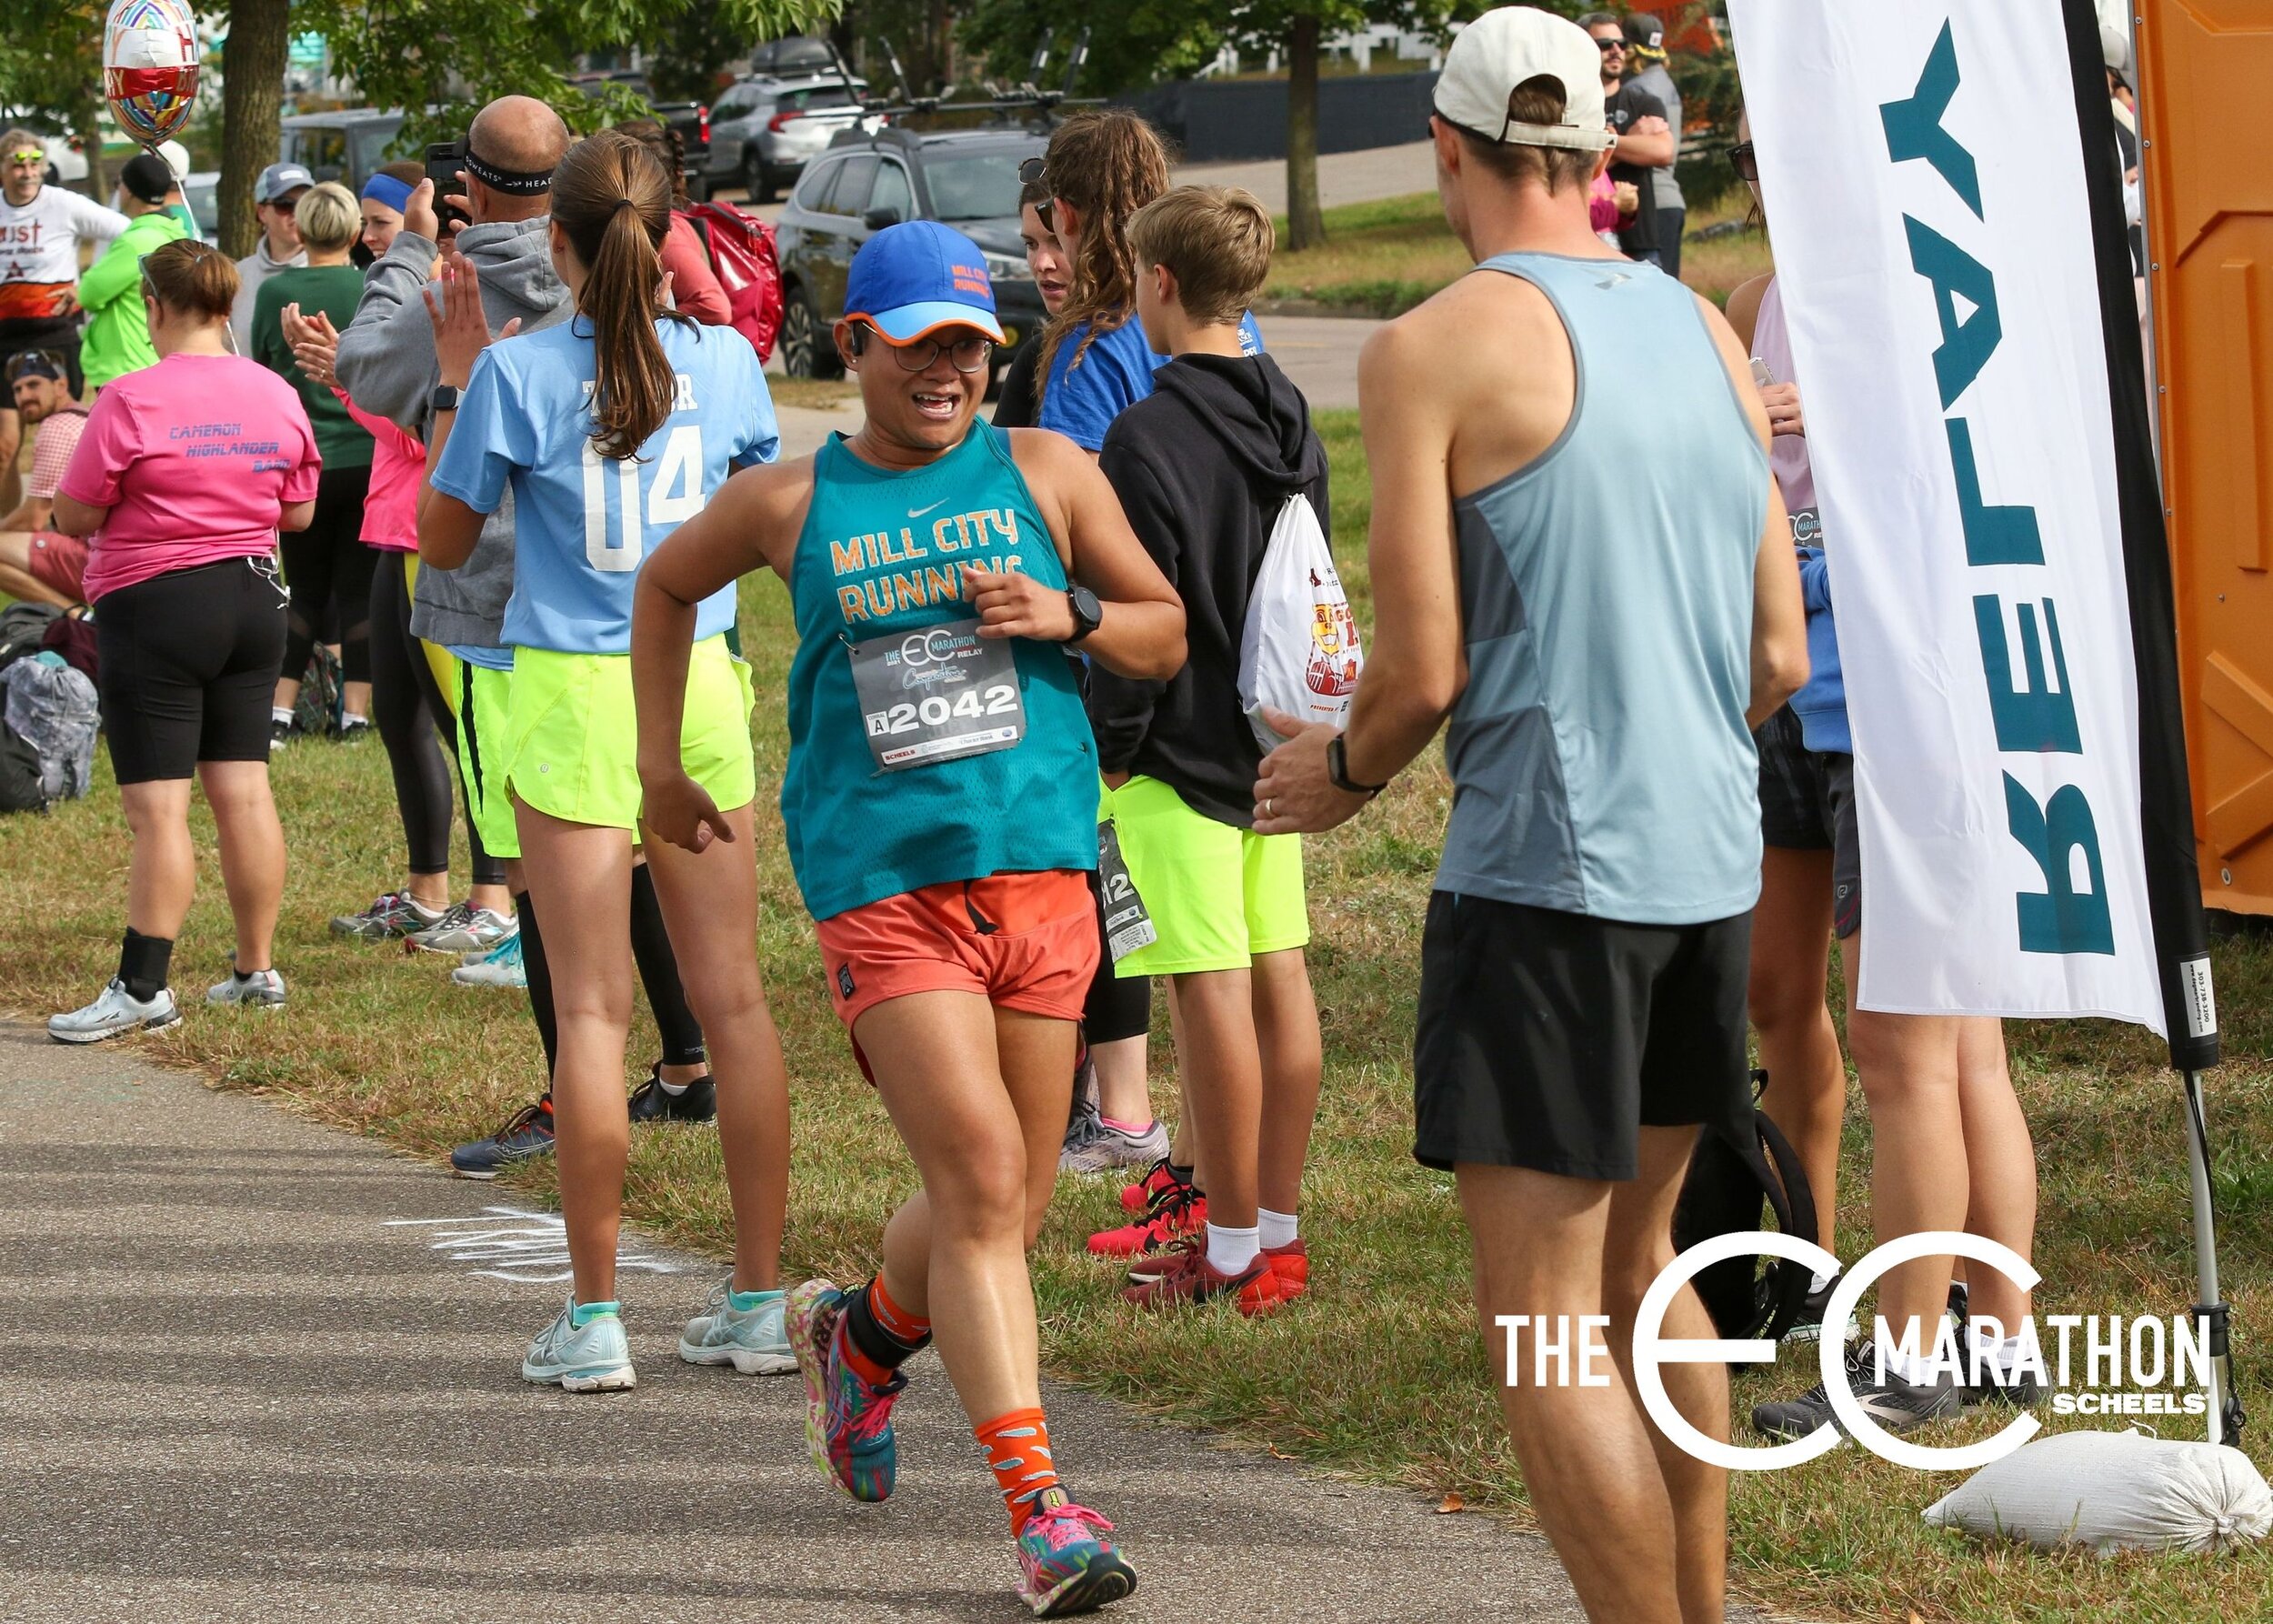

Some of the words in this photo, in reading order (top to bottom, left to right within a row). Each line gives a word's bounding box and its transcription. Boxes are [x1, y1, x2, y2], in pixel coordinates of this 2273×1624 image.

[169, 424, 241, 439] CAMERON
[186, 442, 279, 457] HIGHLANDER
[830, 527, 928, 576] MILL
[933, 508, 1019, 552] CITY
[885, 649, 900, 661] THE
[931, 636, 976, 652] MARATHON
[956, 648, 983, 658] RELAY
[888, 685, 1018, 735] 2042
[875, 719, 885, 733] A
[885, 749, 916, 761] SCHEELS
